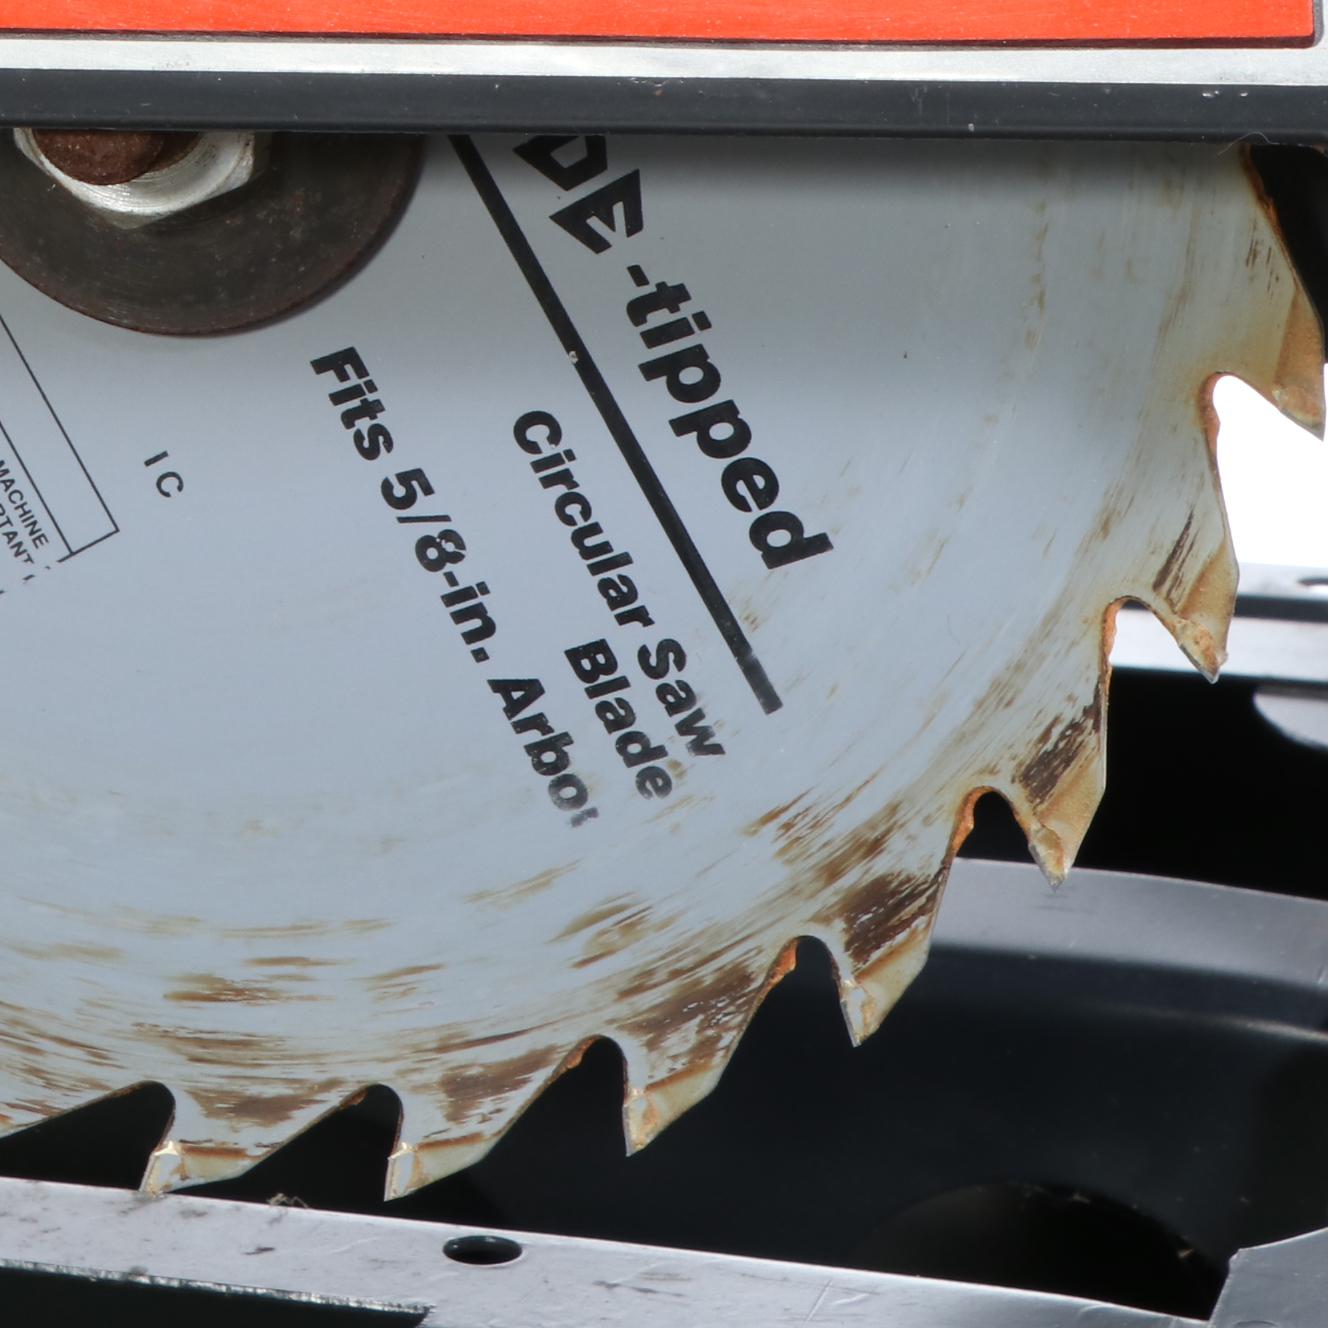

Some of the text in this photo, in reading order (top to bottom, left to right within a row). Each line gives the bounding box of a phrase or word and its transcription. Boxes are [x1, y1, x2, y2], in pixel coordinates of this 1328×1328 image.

[309, 346, 394, 461] Fits
[380, 467, 496, 663] 5/8-in.
[512, 410, 725, 756] Circular Saw
[564, 637, 675, 799] Blade
